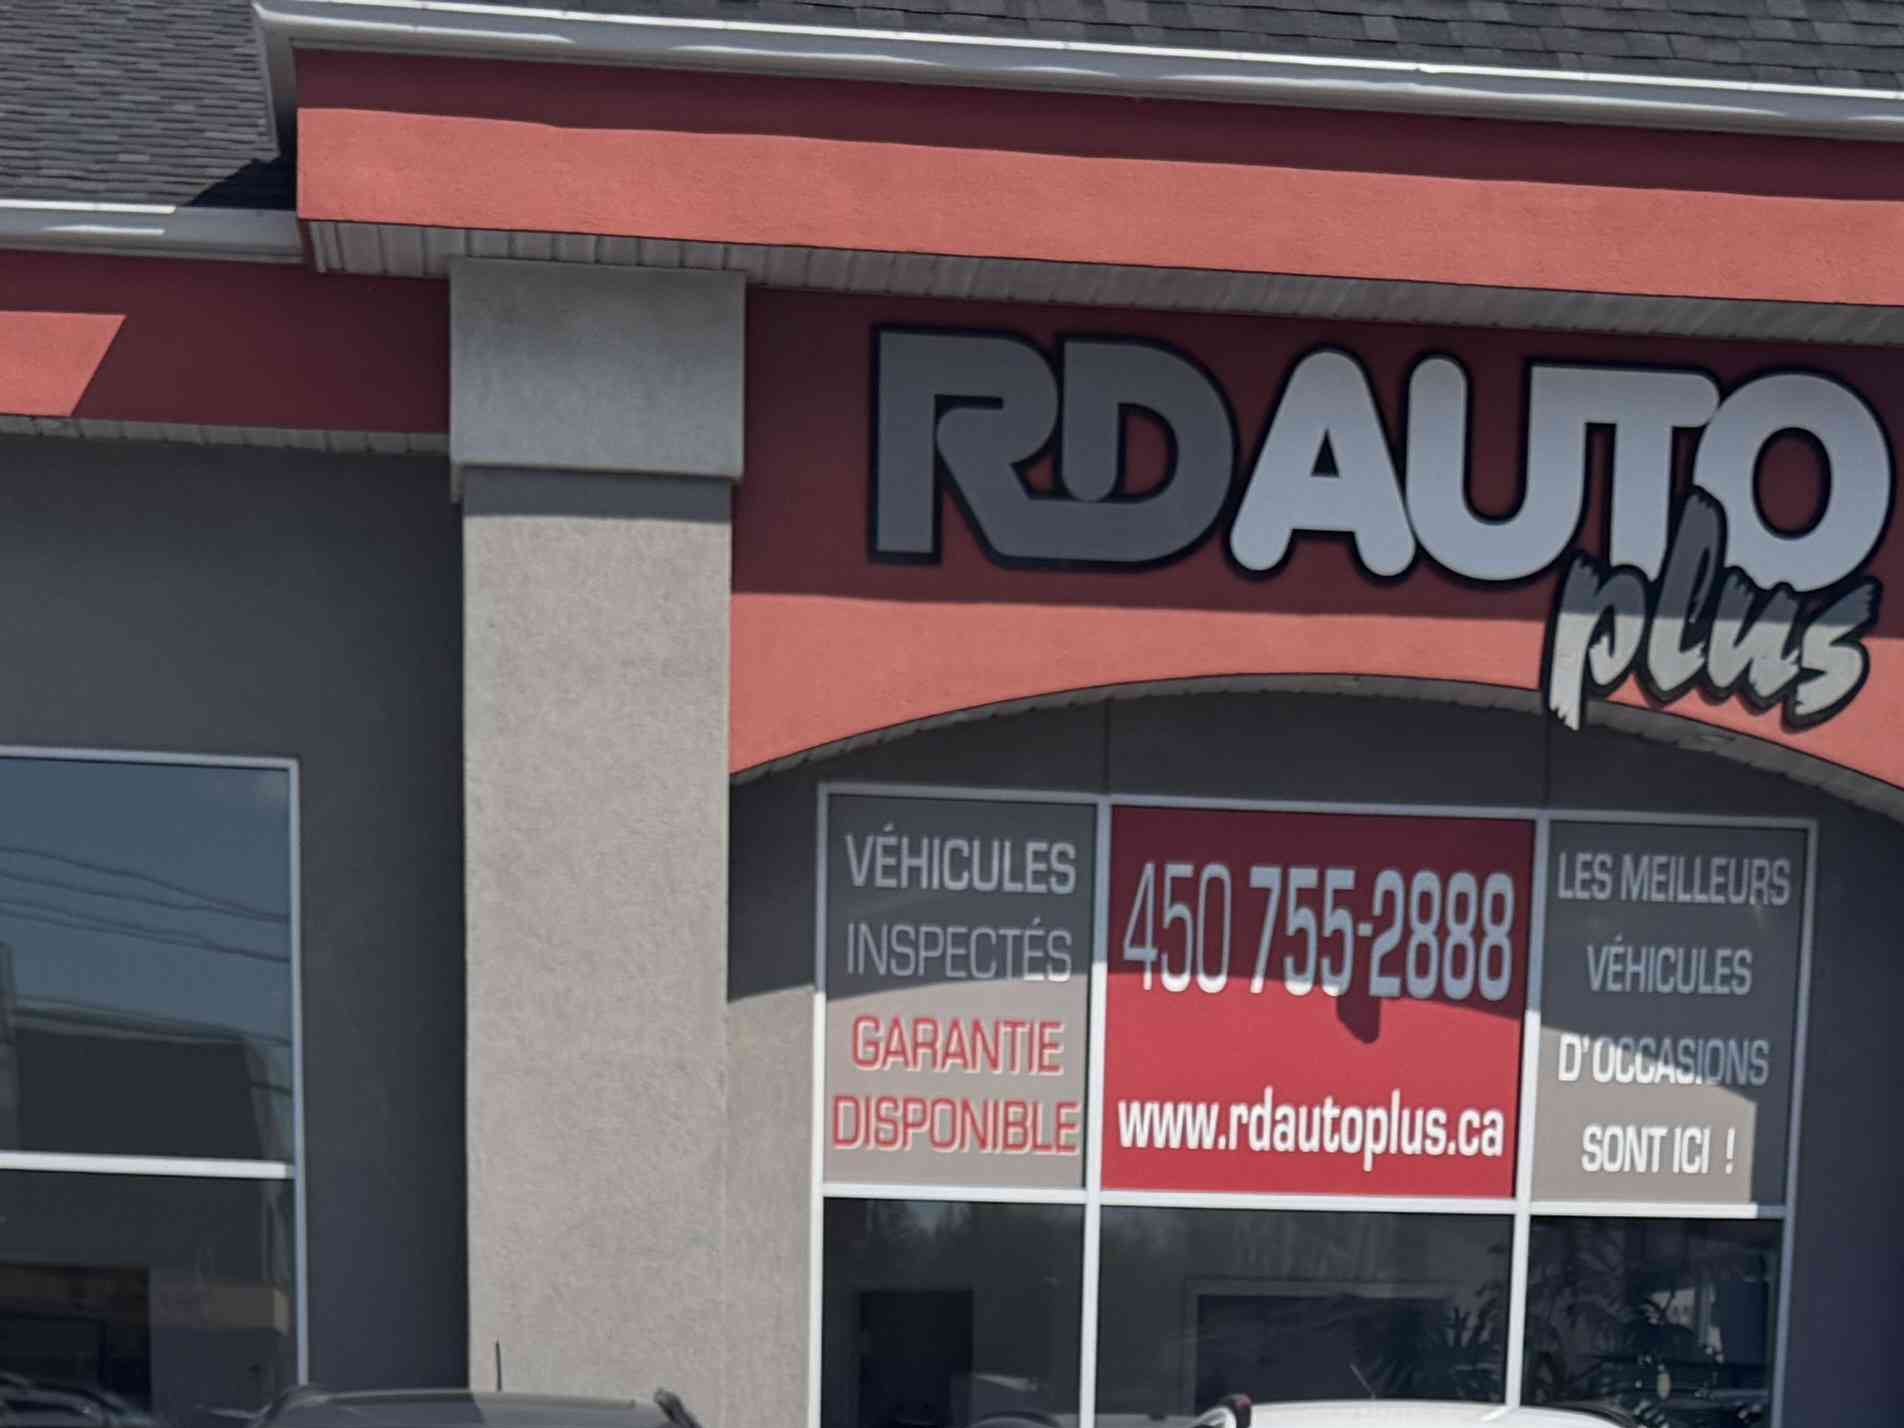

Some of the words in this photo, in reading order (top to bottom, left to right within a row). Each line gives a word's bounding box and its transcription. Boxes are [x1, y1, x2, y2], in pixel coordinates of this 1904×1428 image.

[1545, 484, 1882, 732] plus
[846, 822, 1077, 895] VÉHICULES
[1557, 852, 1613, 901] LES
[1620, 853, 1792, 906] MEILLEURS
[846, 916, 1073, 983] INSPECTÉS
[1122, 861, 1232, 993] 450
[1247, 864, 1515, 1000] 755-2888
[1586, 933, 1754, 996] VÉHICULES
[851, 1015, 1066, 1077] GARANTIE
[1557, 1032, 1770, 1087] D'OCCASIONS
[832, 1095, 1082, 1156] DISPONIBLE
[1117, 1086, 1505, 1172] www.rdautoplus.ca
[1582, 1122, 1668, 1174] SONT
[1672, 1124, 1713, 1175] ICI
